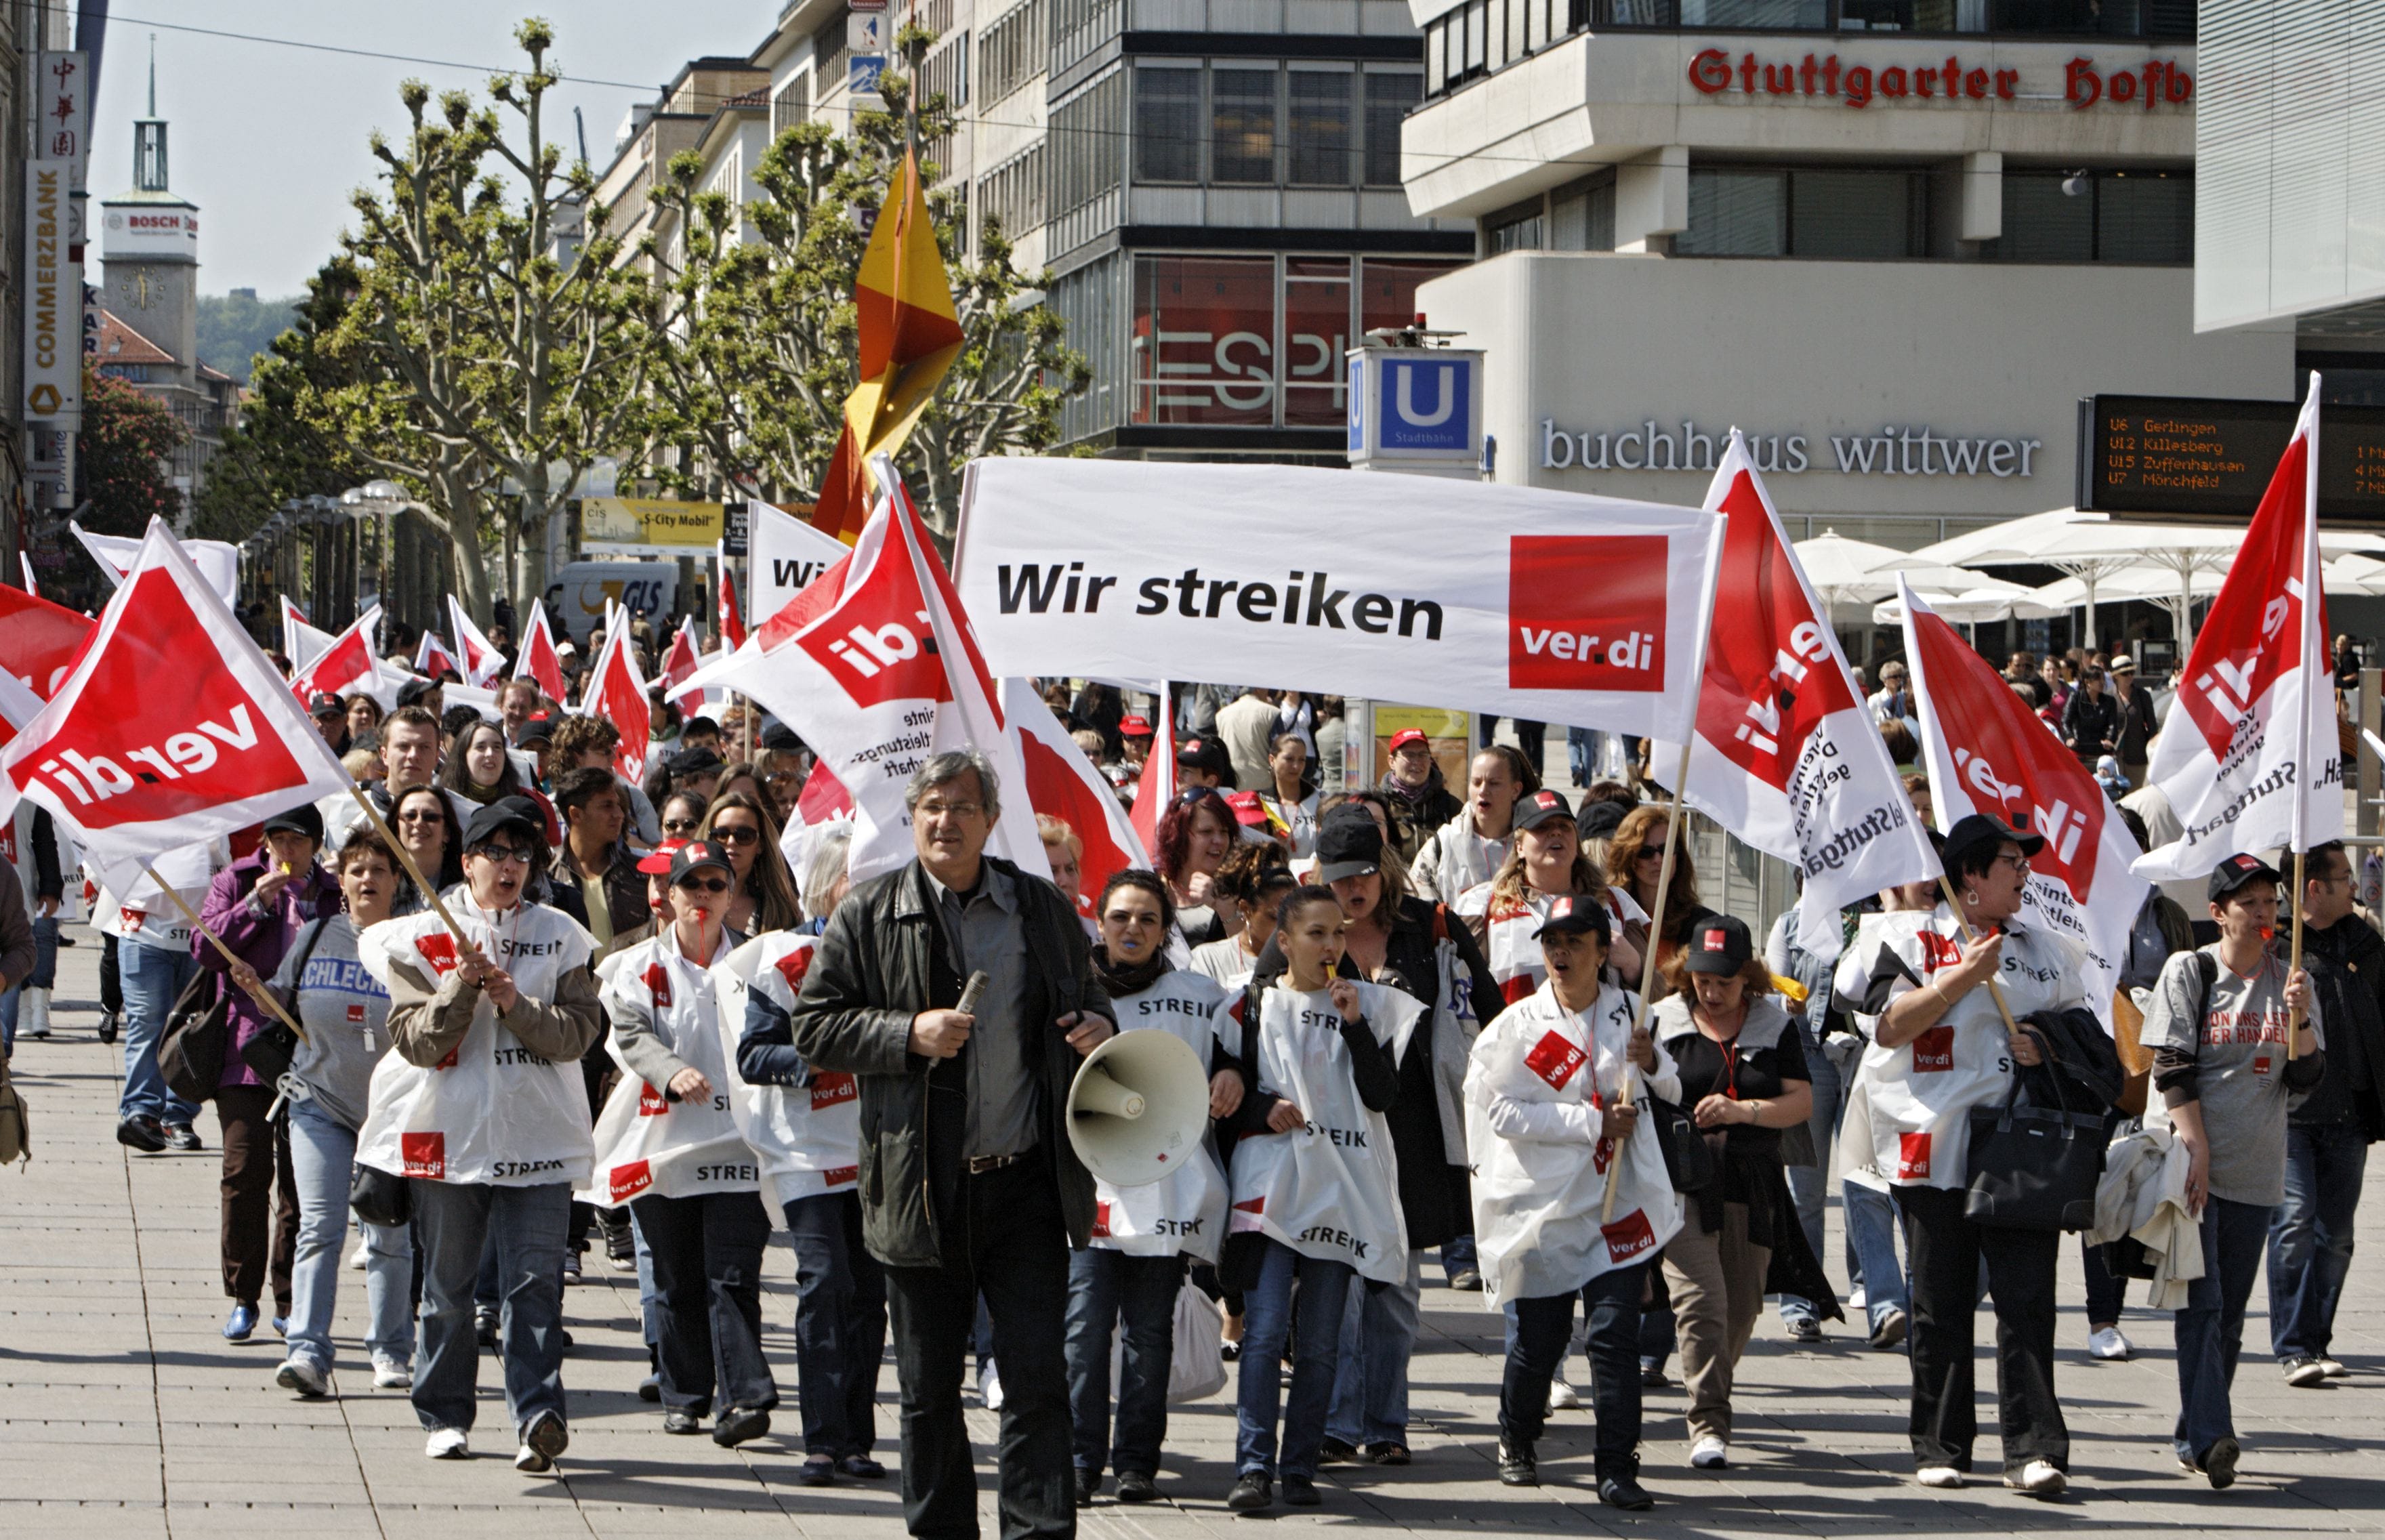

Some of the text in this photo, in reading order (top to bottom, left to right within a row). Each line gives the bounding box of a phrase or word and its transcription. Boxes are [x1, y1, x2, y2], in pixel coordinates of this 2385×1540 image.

[1688, 47, 2019, 109] Stuttgarter
[50, 58, 76, 157] 中華園
[129, 215, 180, 228] BOSCH
[36, 170, 58, 369] COMMERZBANK
[1396, 365, 1454, 427] U
[1395, 431, 1455, 444] Stadtbahn
[2110, 419, 2217, 435] U6 Gerlingen
[1829, 426, 2041, 477] wittwer
[2109, 437, 2223, 455] U12 Killesberg
[2109, 455, 2244, 473] U15 Zuffenhausen
[2109, 472, 2220, 489] U7 Mönchfeld
[587, 509, 606, 518] CIS
[622, 581, 663, 615] GLS
[998, 562, 1443, 640] Wir streiken
[1520, 627, 1653, 671] ver.di
